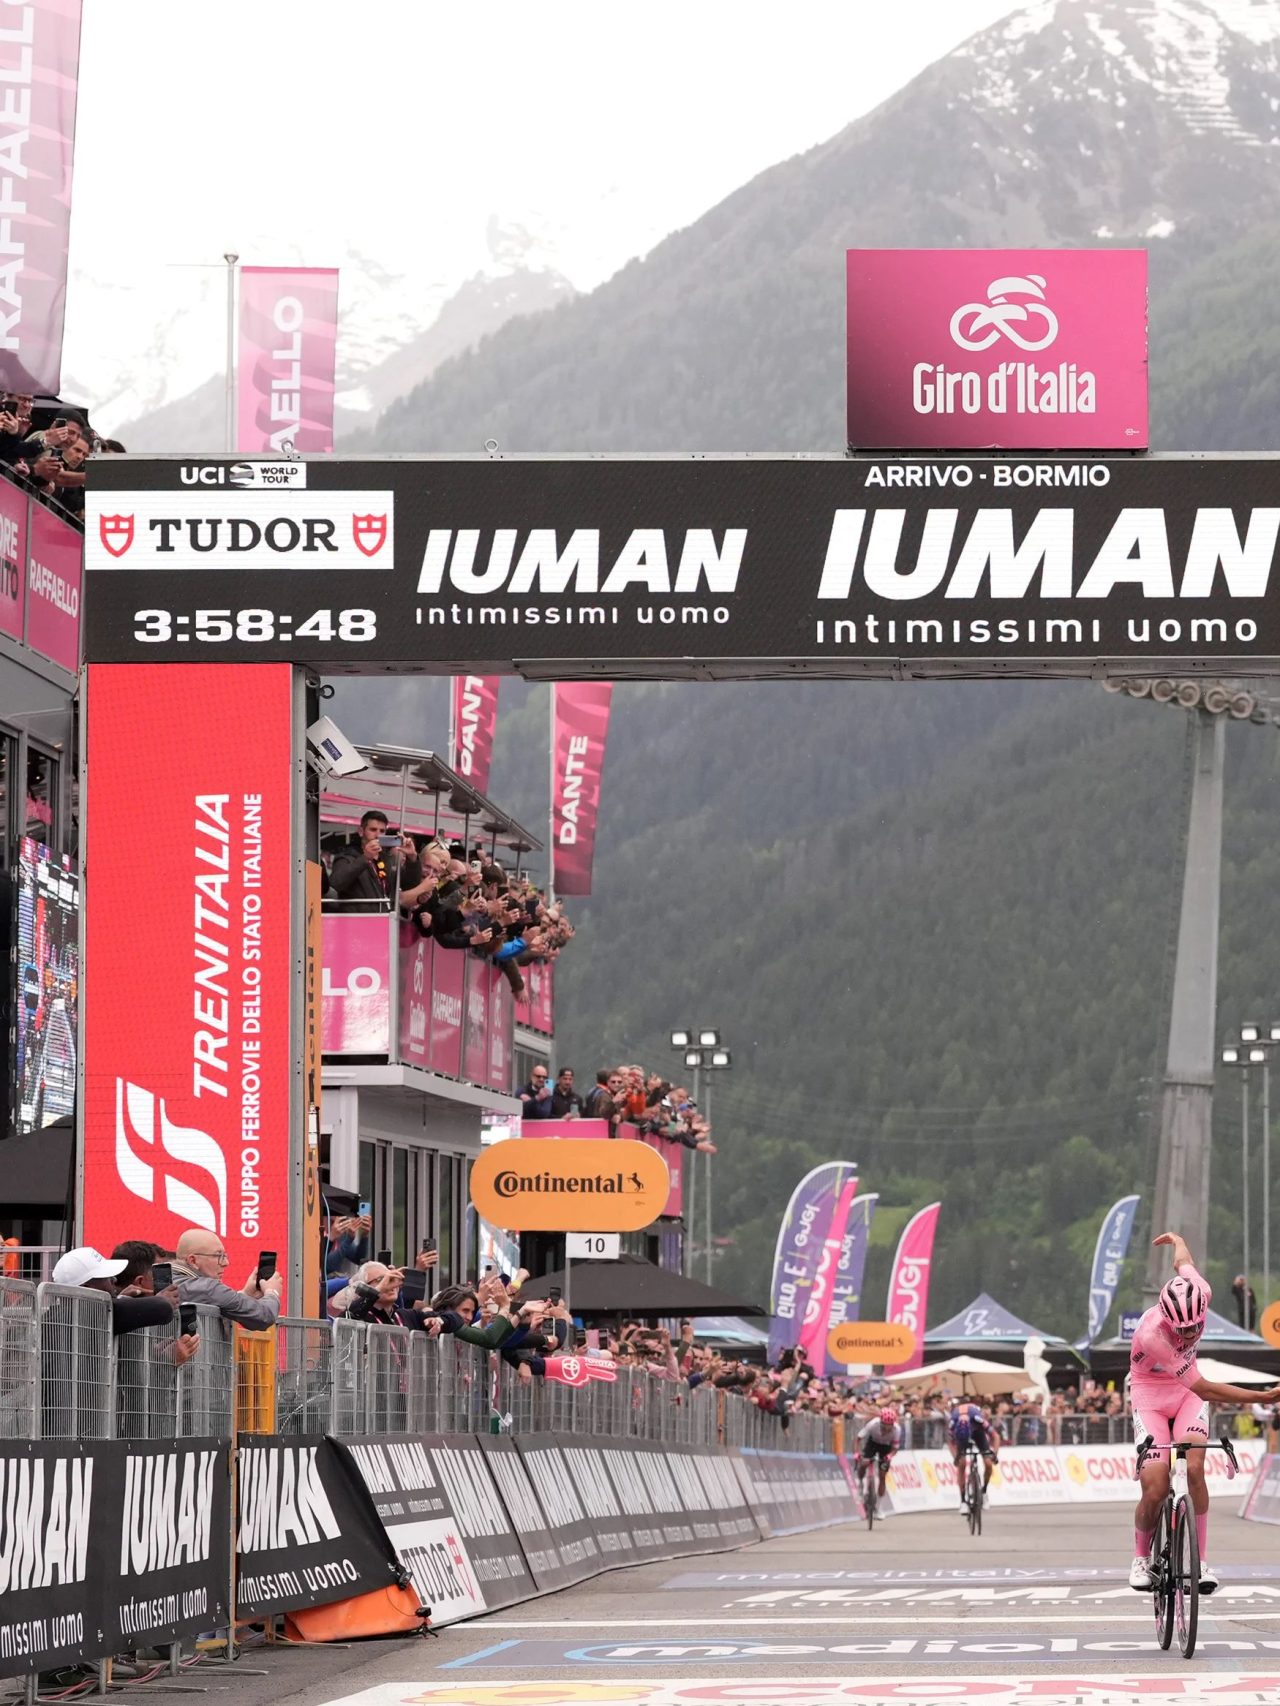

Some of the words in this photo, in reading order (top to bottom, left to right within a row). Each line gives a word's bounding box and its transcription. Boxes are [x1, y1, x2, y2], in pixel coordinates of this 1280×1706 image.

[912, 362, 980, 413] Giro
[988, 362, 1096, 413] d'Italia
[180, 466, 225, 484] UCI
[260, 467, 299, 476] WORLD
[261, 475, 290, 484] TOUR
[864, 465, 973, 487] ARRIVO
[993, 465, 1110, 487] BORMIO
[150, 518, 339, 552] TUDOR
[417, 529, 748, 594] IUMAN
[30, 558, 78, 618] RAFFAELLO
[134, 608, 377, 643] 3:58:48
[416, 604, 618, 625] intimissimi
[637, 607, 730, 624] uomo
[816, 615, 1101, 644] intimissimi
[1127, 618, 1258, 643] uomo
[560, 736, 588, 844] DANTE
[243, 793, 262, 888] ITALIANE
[194, 793, 230, 1098] TRENITALIA
[242, 894, 261, 960] STATO
[242, 967, 261, 1033] DELLO
[241, 1040, 260, 1141] FERROVIE
[241, 1147, 259, 1238] GRUPPO
[494, 1171, 623, 1197] Continental
[585, 1238, 605, 1253] 10
[837, 1337, 895, 1349] Continental
[431, 1446, 510, 1538] IUMAN
[1001, 1459, 1060, 1482] CONAD
[120, 1450, 217, 1576] IUMAN
[310, 1557, 358, 1591] uomo
[400, 1542, 464, 1604] TUDOR
[119, 1594, 180, 1635] intimissimi
[183, 1586, 208, 1617] uomo
[721, 1599, 1104, 1608] intimissimi
[52, 1611, 83, 1648] uomo
